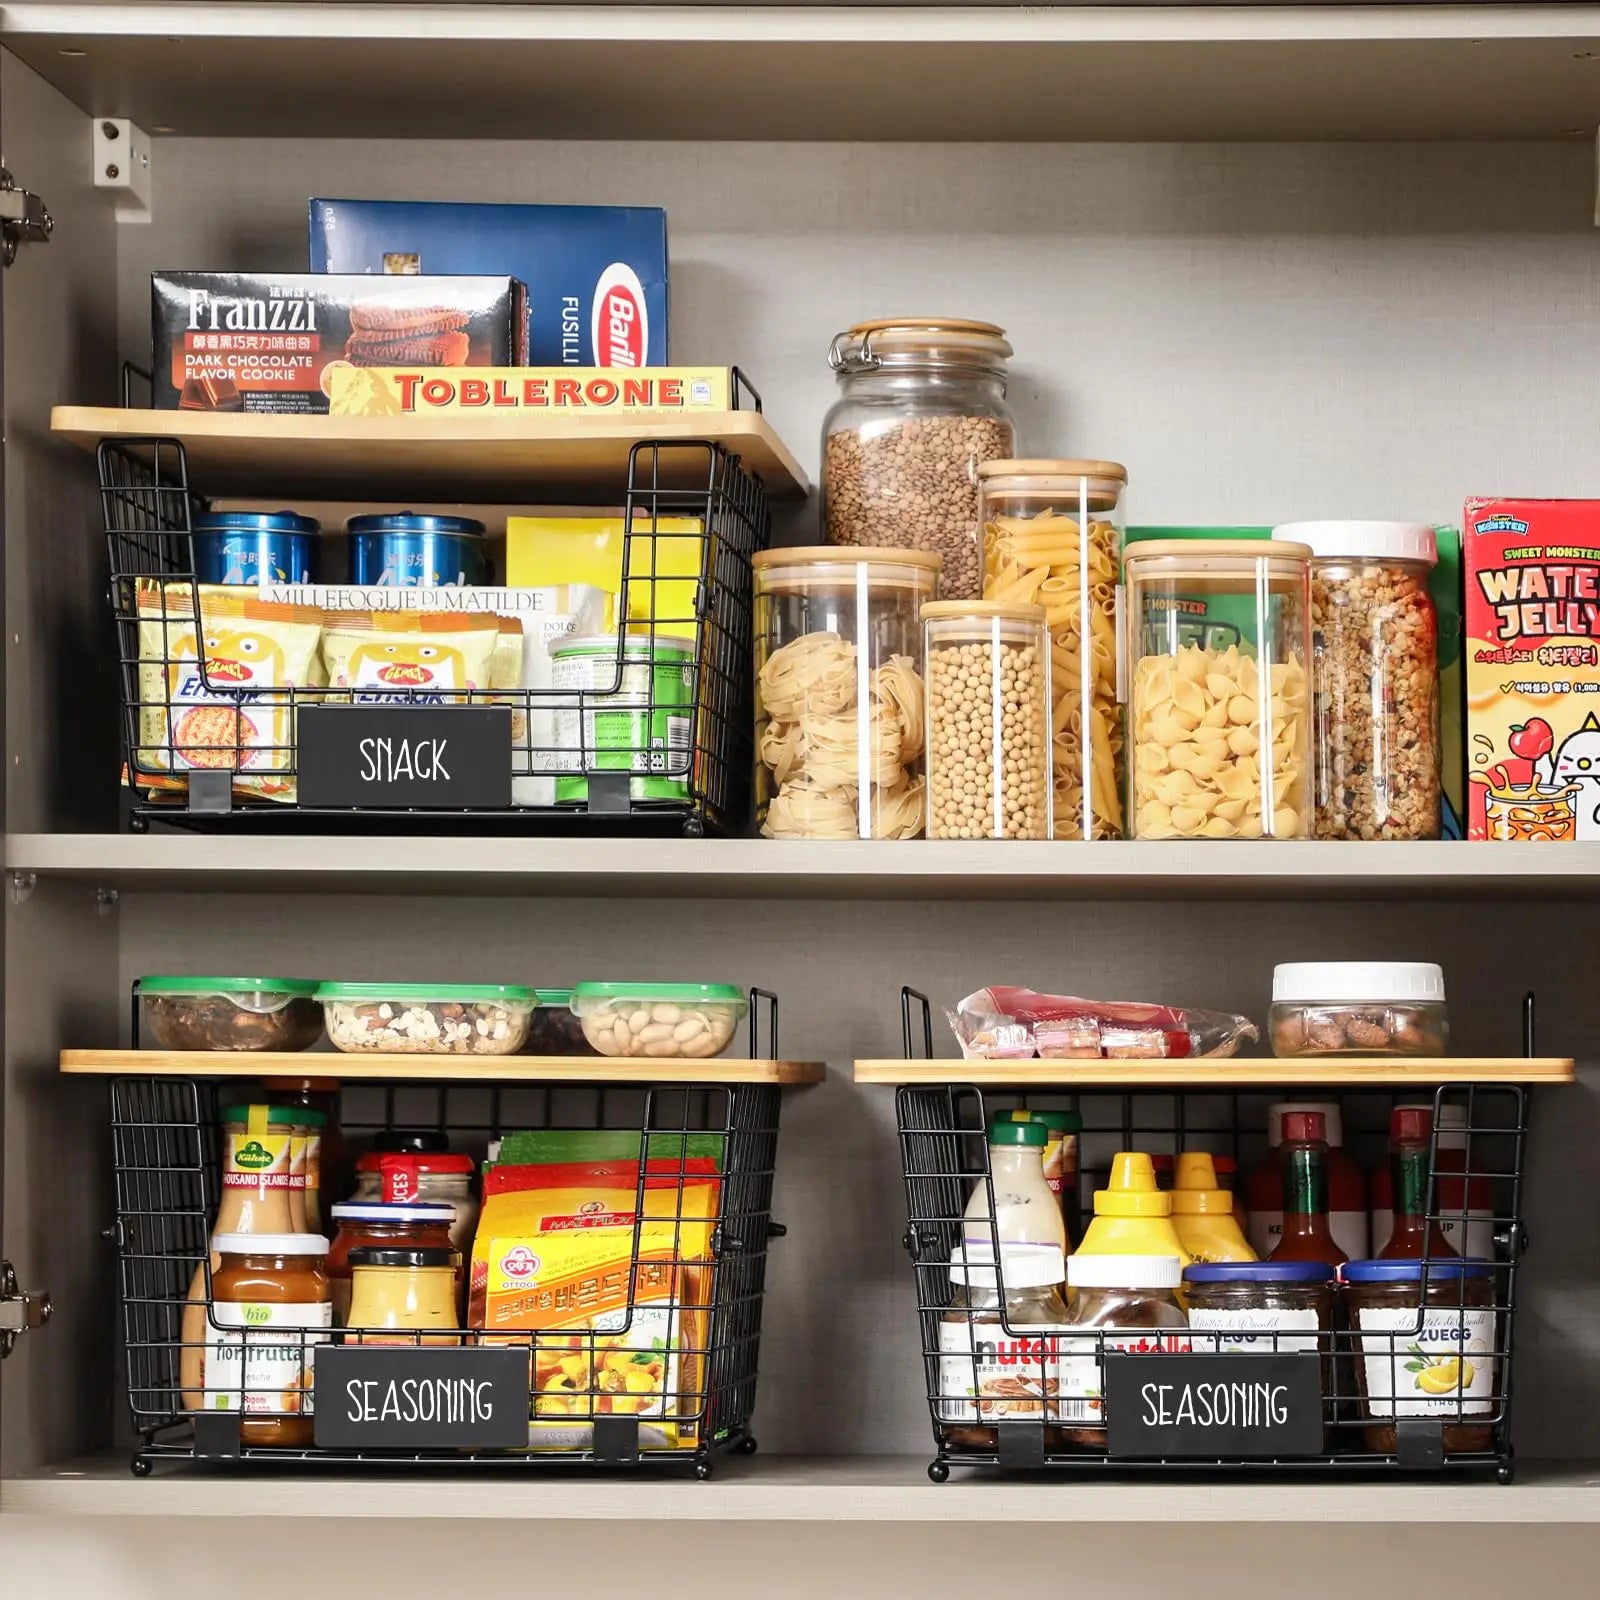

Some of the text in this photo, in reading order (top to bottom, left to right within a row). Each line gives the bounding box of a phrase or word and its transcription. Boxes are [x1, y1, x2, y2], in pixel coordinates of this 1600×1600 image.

[187, 289, 317, 331] Franzzi
[561, 297, 579, 362] FUSILLI
[185, 355, 313, 368] DARK CHOCOLATE
[185, 367, 296, 381] FLAVOR COOKIE
[394, 375, 684, 412] TOBLERONE
[1504, 547, 1542, 560] SWEET
[272, 589, 544, 611] MILLEFOGLIE DI MATILDE
[544, 622, 577, 633] DOLCE
[1497, 602, 1600, 638] JELLY
[1539, 646, 1597, 666] 워터젤리
[359, 737, 451, 783] SNACK
[259, 1174, 289, 1186] ISLANDS
[550, 1218, 585, 1229] MAE
[246, 1307, 269, 1321] bio
[1418, 1328, 1472, 1342] ZUEGG
[246, 1373, 271, 1381] esche
[346, 1379, 493, 1424] SEASONING
[1141, 1382, 1288, 1428] SEASONING
